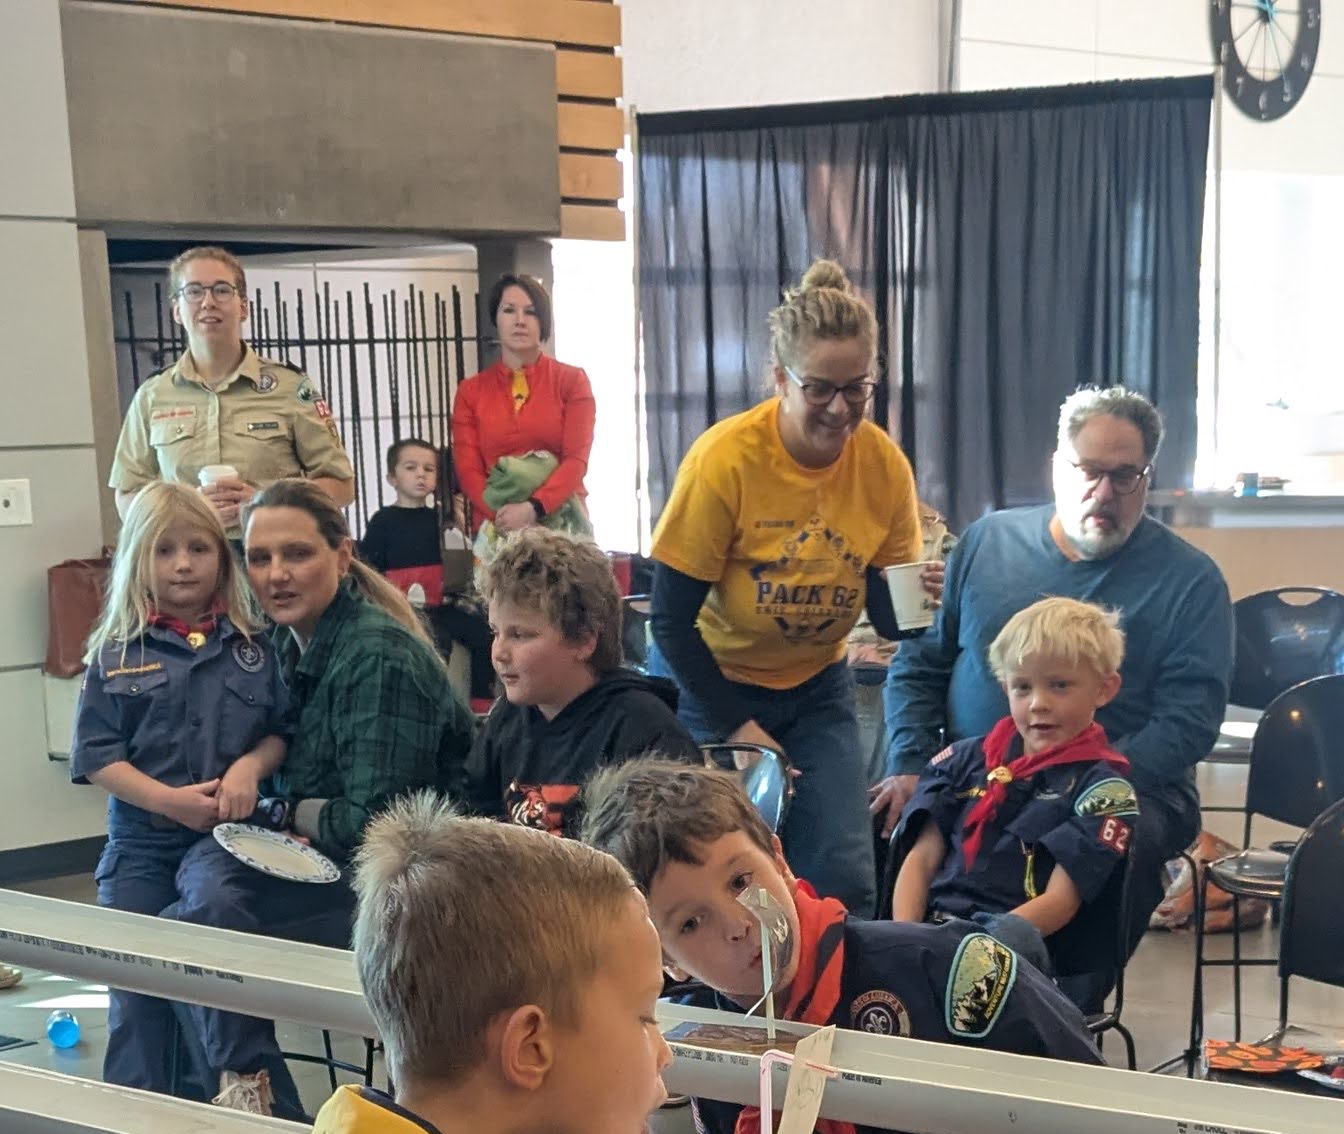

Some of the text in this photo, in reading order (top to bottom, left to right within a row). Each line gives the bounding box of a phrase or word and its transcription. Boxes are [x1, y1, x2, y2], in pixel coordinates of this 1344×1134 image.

[757, 582, 859, 609] PACK 62
[1103, 819, 1130, 850] 62
